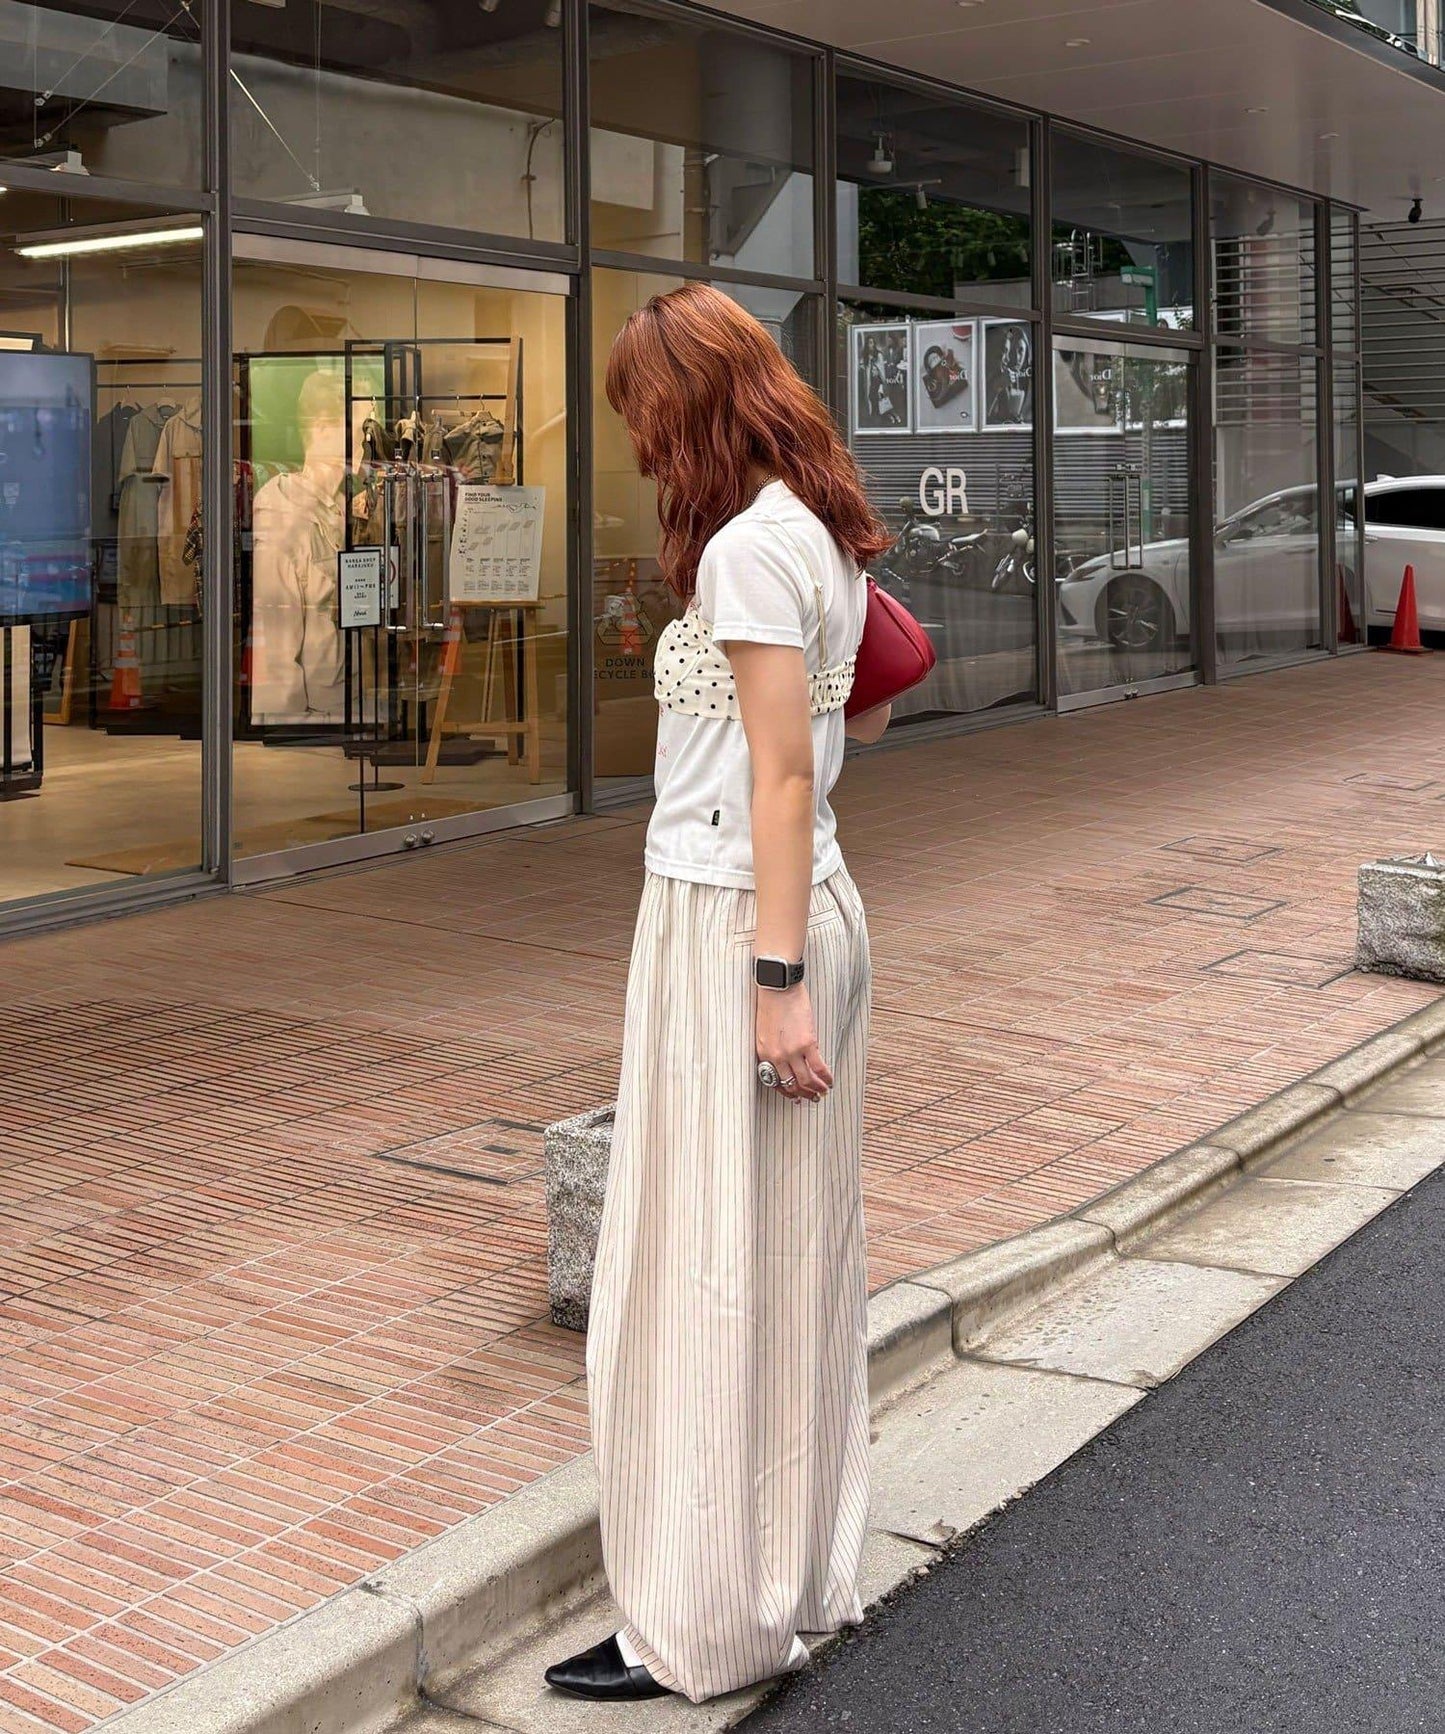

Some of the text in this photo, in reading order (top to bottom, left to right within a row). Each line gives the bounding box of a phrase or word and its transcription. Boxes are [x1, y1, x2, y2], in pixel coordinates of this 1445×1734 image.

[919, 467, 969, 516] GR
[605, 658, 645, 668] DOWN
[594, 670, 637, 679] ECYCLE
